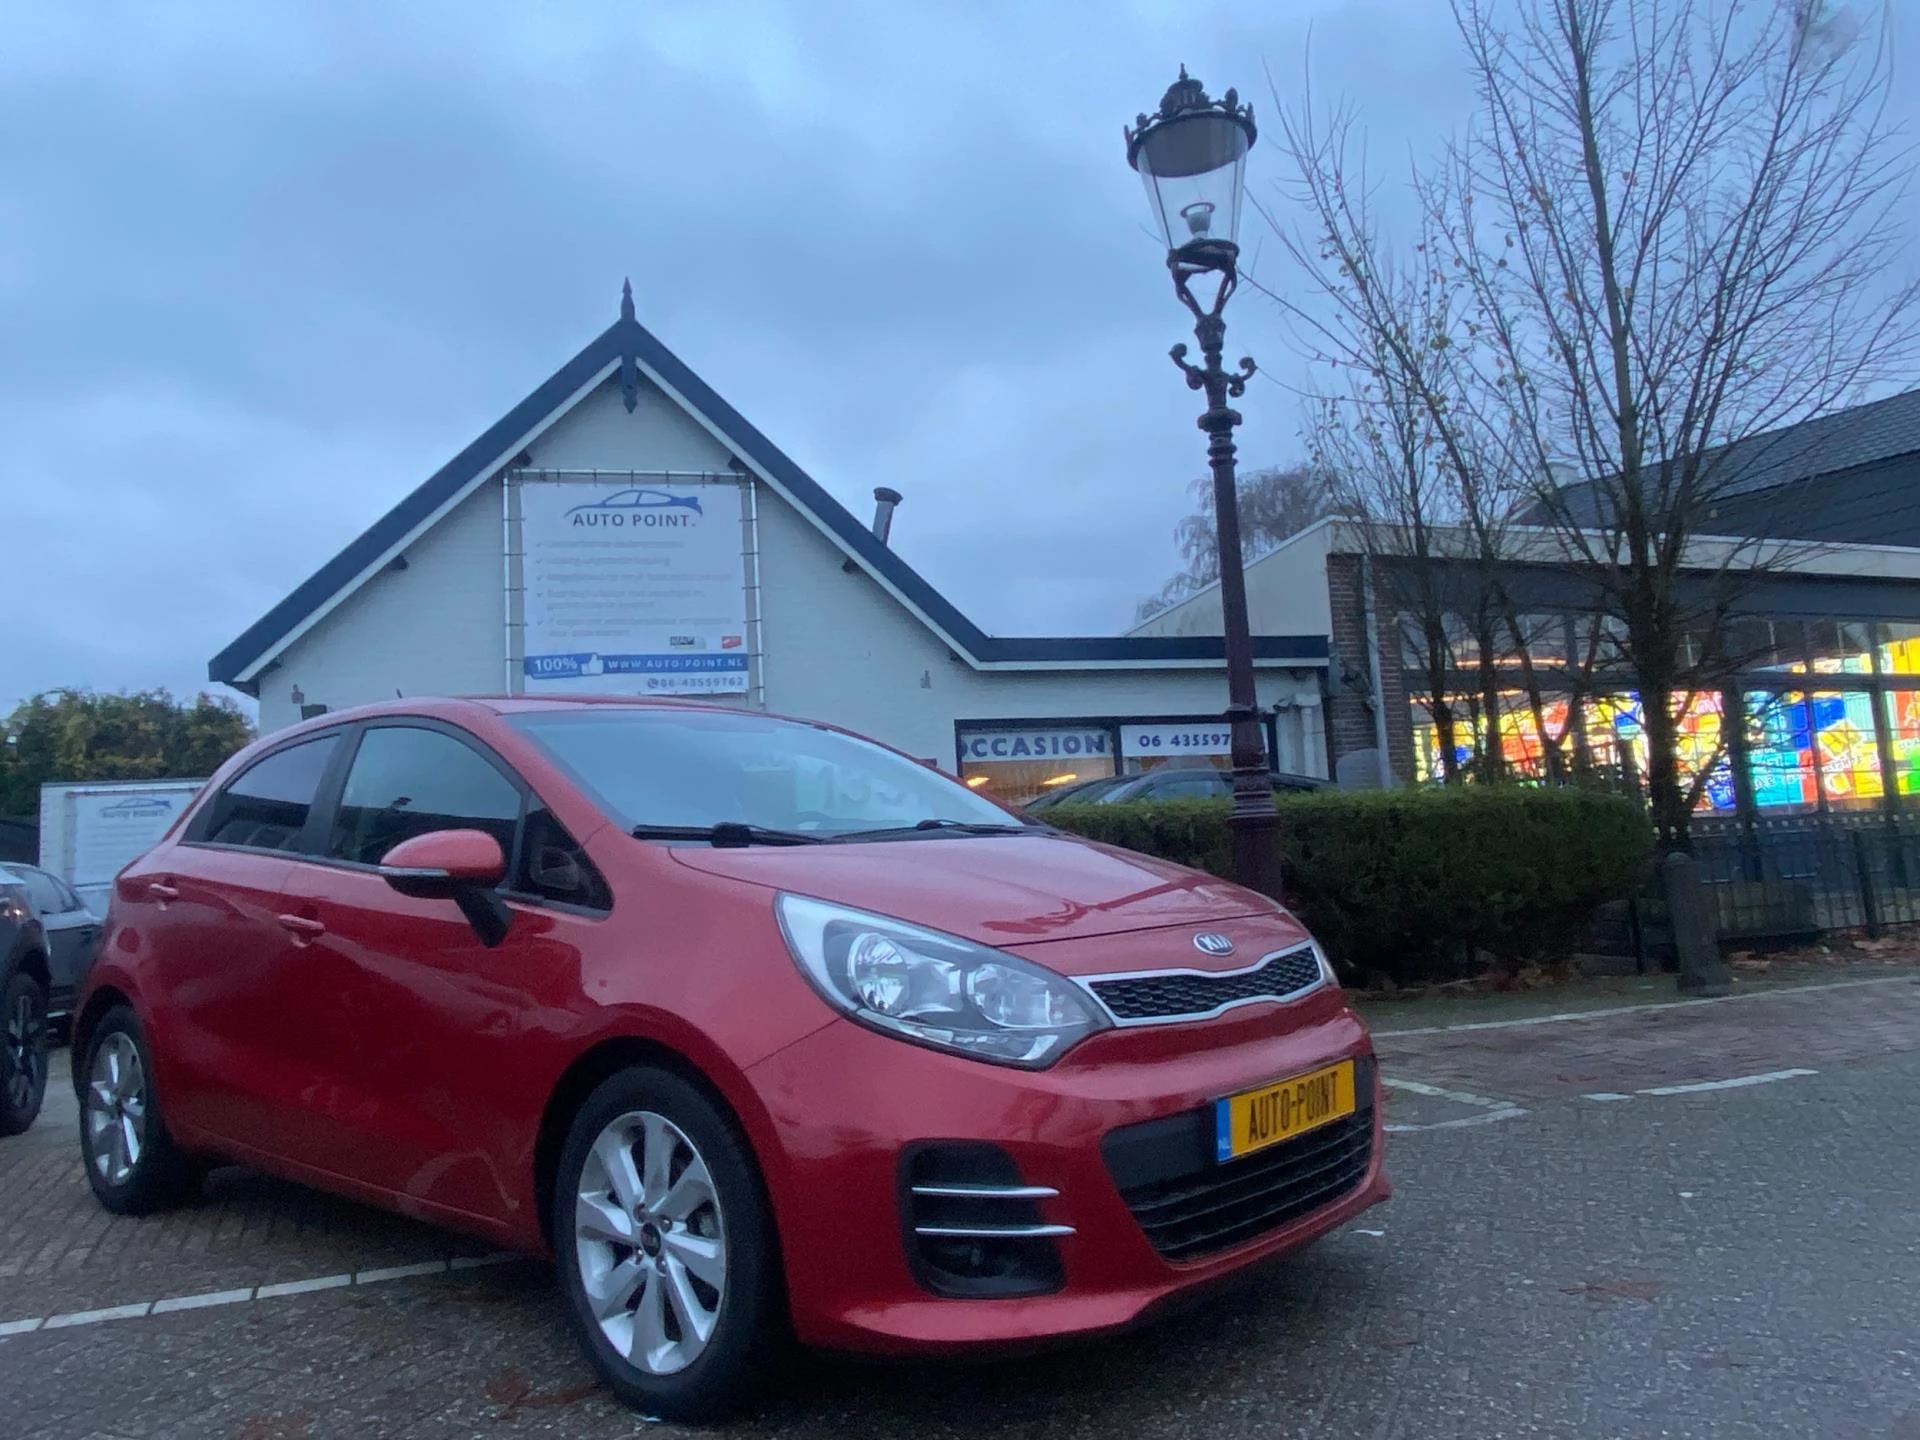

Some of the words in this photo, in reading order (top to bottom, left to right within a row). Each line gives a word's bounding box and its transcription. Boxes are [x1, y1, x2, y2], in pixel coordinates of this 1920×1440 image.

[573, 513, 625, 527] AUTO
[534, 656, 578, 673] 100%
[1139, 735, 1161, 747] 06
[1198, 934, 1233, 951] KIA
[1248, 1070, 1338, 1144] AUTO-POINT
